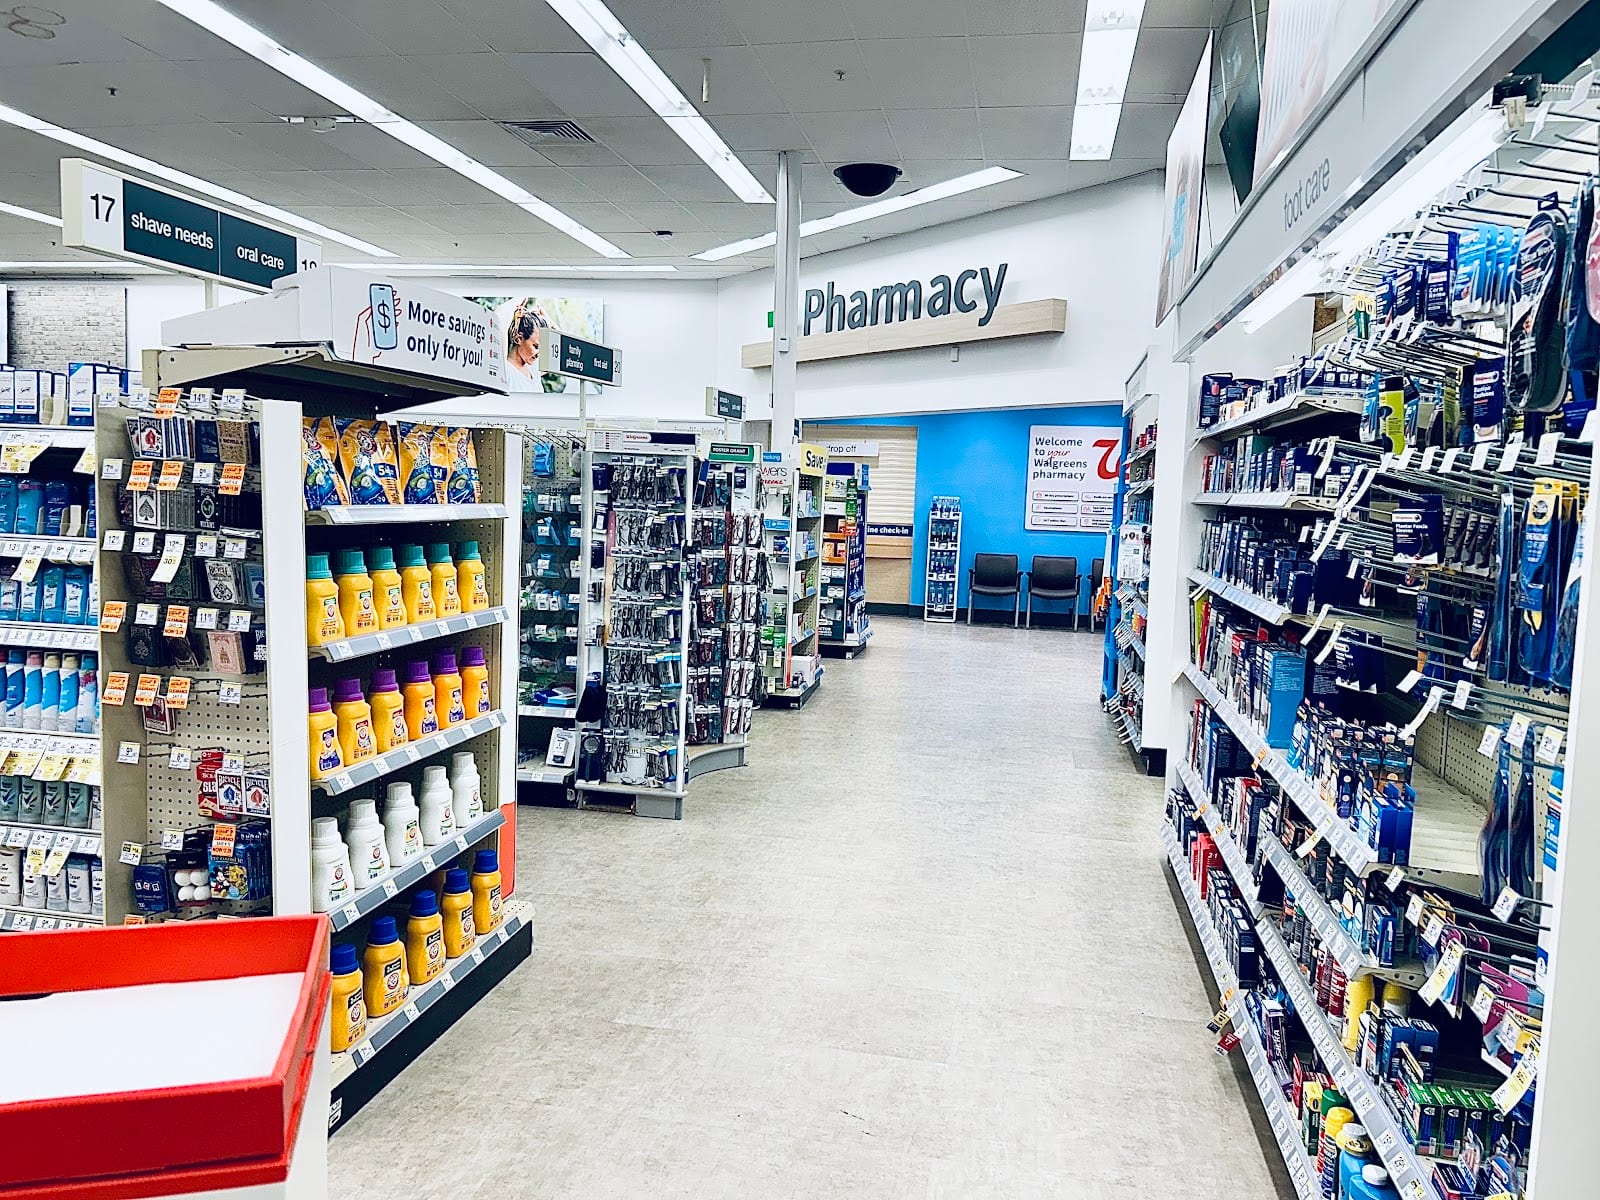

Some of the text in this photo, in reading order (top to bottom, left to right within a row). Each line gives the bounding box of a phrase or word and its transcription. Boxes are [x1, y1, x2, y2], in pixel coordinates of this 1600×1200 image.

[1284, 157, 1330, 232] foot care
[90, 193, 116, 222] 17
[131, 212, 214, 250] shave needs
[236, 243, 285, 270] oral care
[803, 263, 1008, 336] Pharmacy
[408, 300, 445, 329] More
[449, 314, 486, 343] savings
[407, 335, 484, 368] only for you!
[551, 344, 559, 359] 19
[568, 344, 582, 358] family
[564, 356, 585, 371] planning
[593, 357, 602, 368] first
[845, 444, 857, 453] off
[1035, 436, 1083, 447] Welcome
[763, 454, 781, 462] moking
[805, 450, 824, 469] Save
[1034, 447, 1070, 461] to your
[1034, 458, 1088, 470] Walgreens
[1032, 469, 1086, 481] pharmacy
[879, 526, 909, 535] check-in
[218, 775, 241, 788] BICYCLE
[245, 778, 269, 791] BICYCLE
